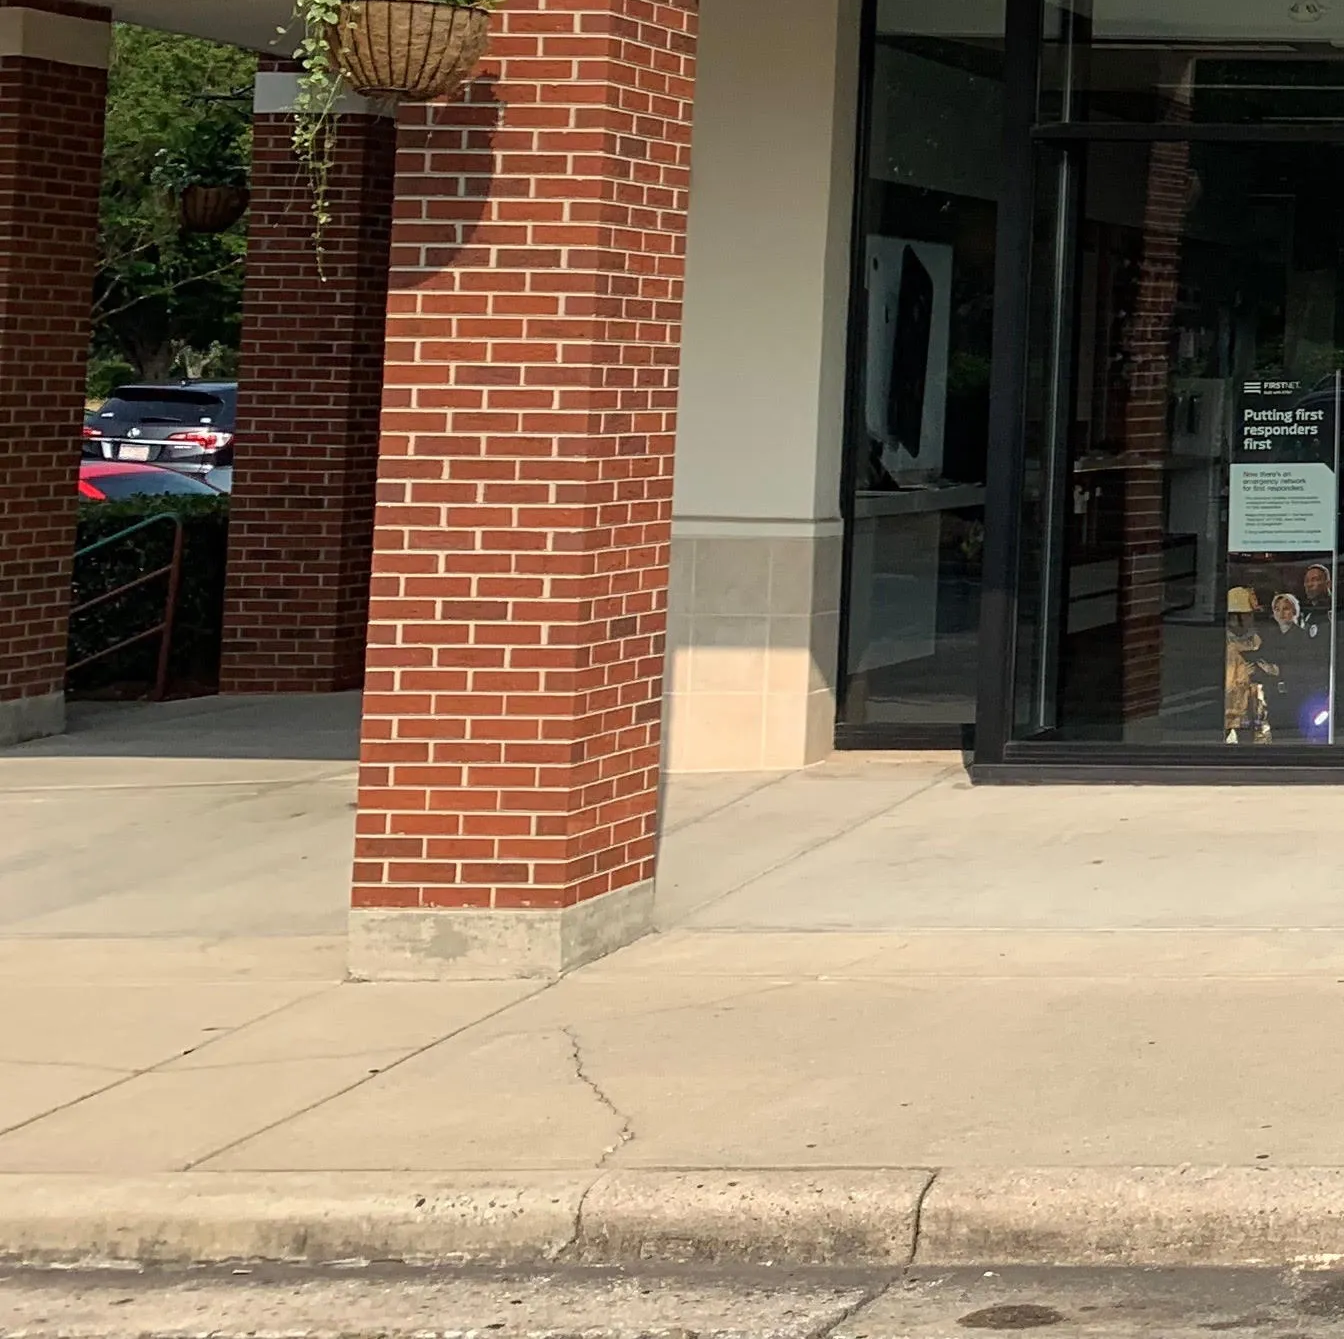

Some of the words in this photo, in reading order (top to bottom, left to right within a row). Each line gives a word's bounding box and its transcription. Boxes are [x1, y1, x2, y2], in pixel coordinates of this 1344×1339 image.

[1244, 408, 1293, 423] Putting
[1295, 408, 1324, 421] first
[1243, 423, 1318, 437] responders
[1243, 437, 1272, 450] first
